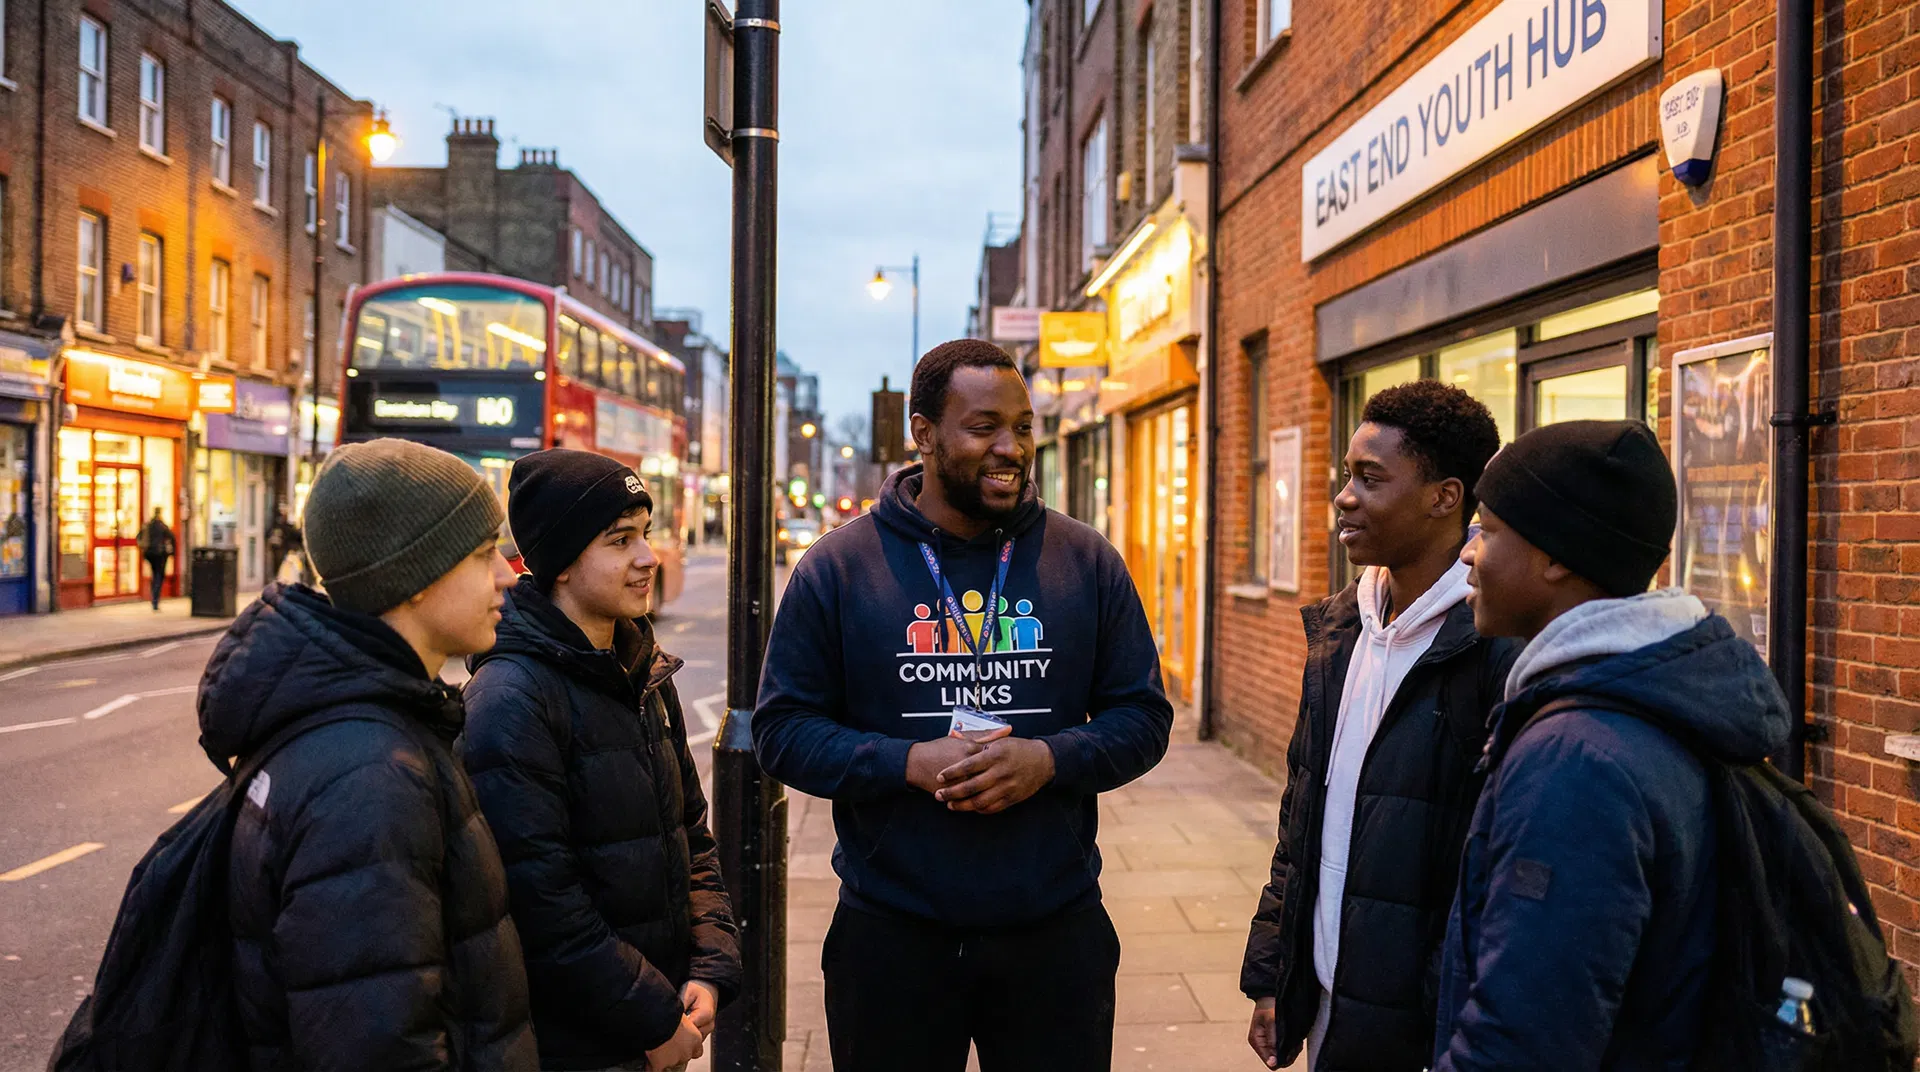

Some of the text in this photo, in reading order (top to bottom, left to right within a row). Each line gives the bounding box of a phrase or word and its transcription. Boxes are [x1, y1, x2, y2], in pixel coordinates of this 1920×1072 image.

[1316, 0, 1606, 228] EAST END YOUTH HUB
[899, 659, 1051, 682] COMMUNITY
[941, 685, 1012, 706] LINKS
